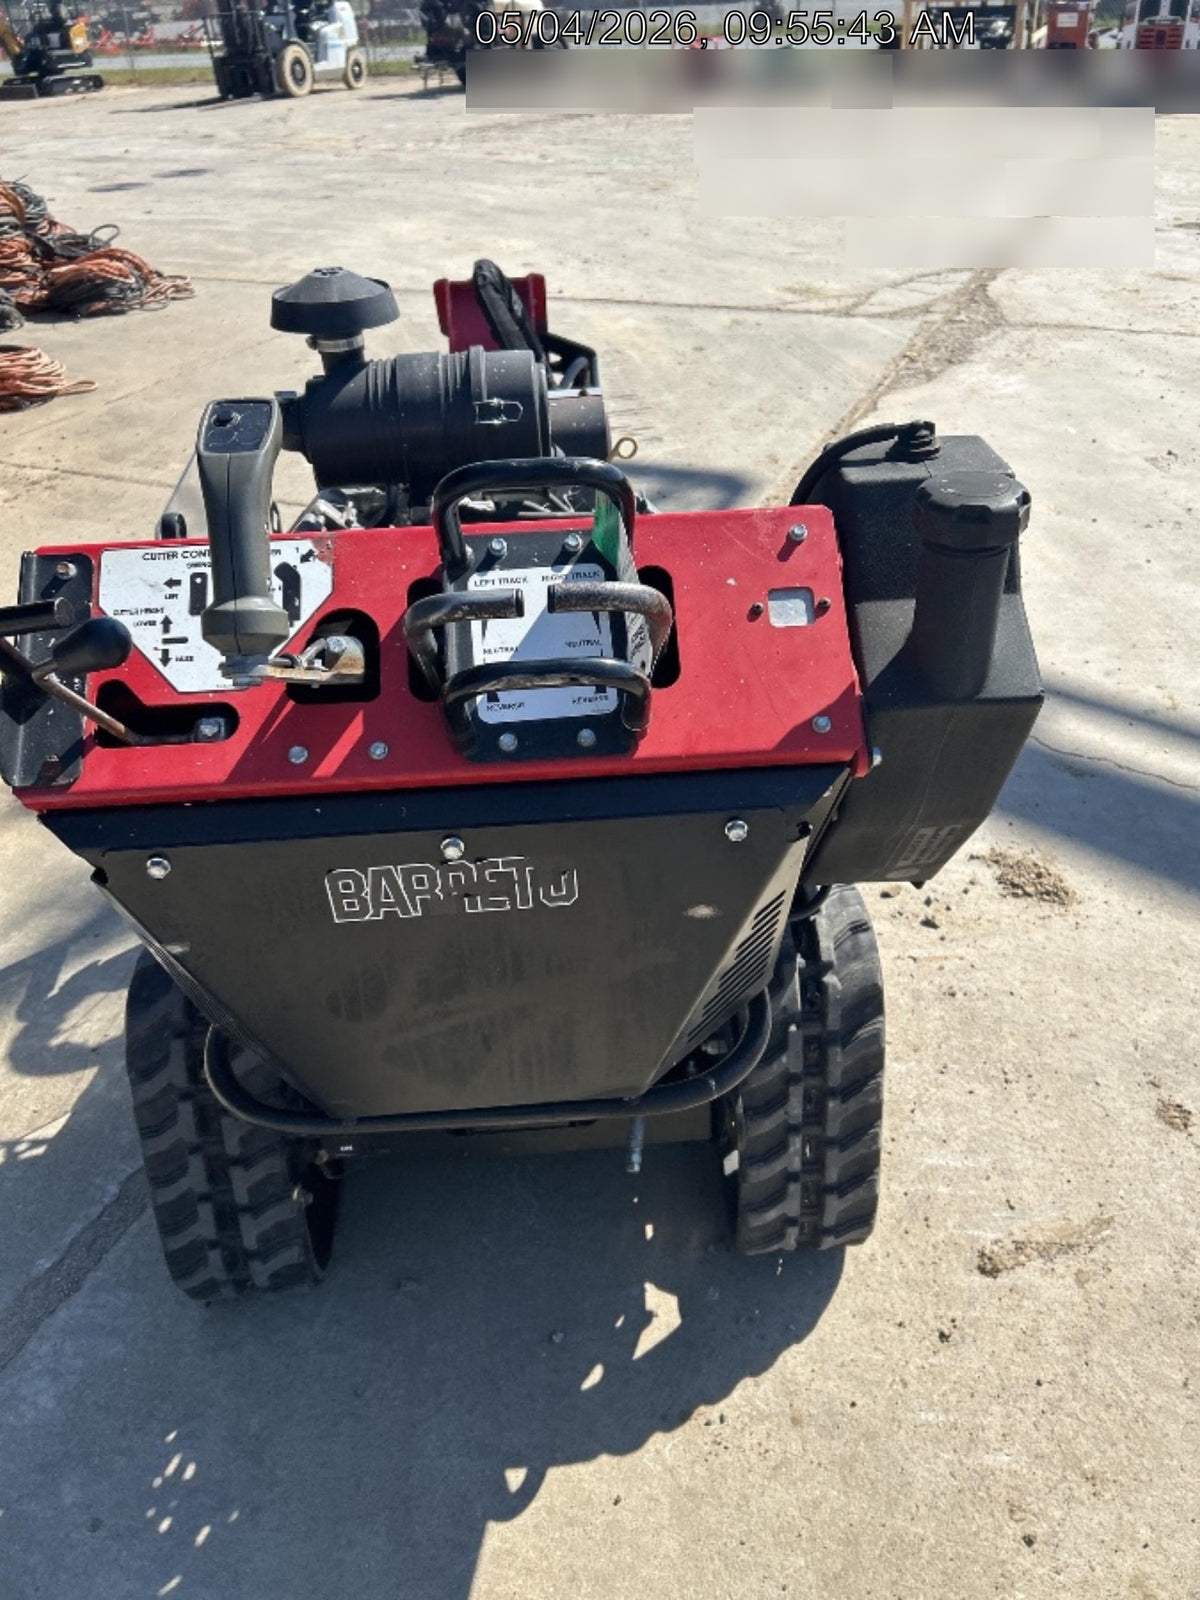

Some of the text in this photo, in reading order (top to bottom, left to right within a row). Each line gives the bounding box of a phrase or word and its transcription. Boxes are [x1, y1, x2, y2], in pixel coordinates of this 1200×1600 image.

[142, 549, 211, 561] CUTTER CONT
[474, 576, 528, 587] LEFT TRACK
[541, 570, 600, 582] RIGHT TRACK
